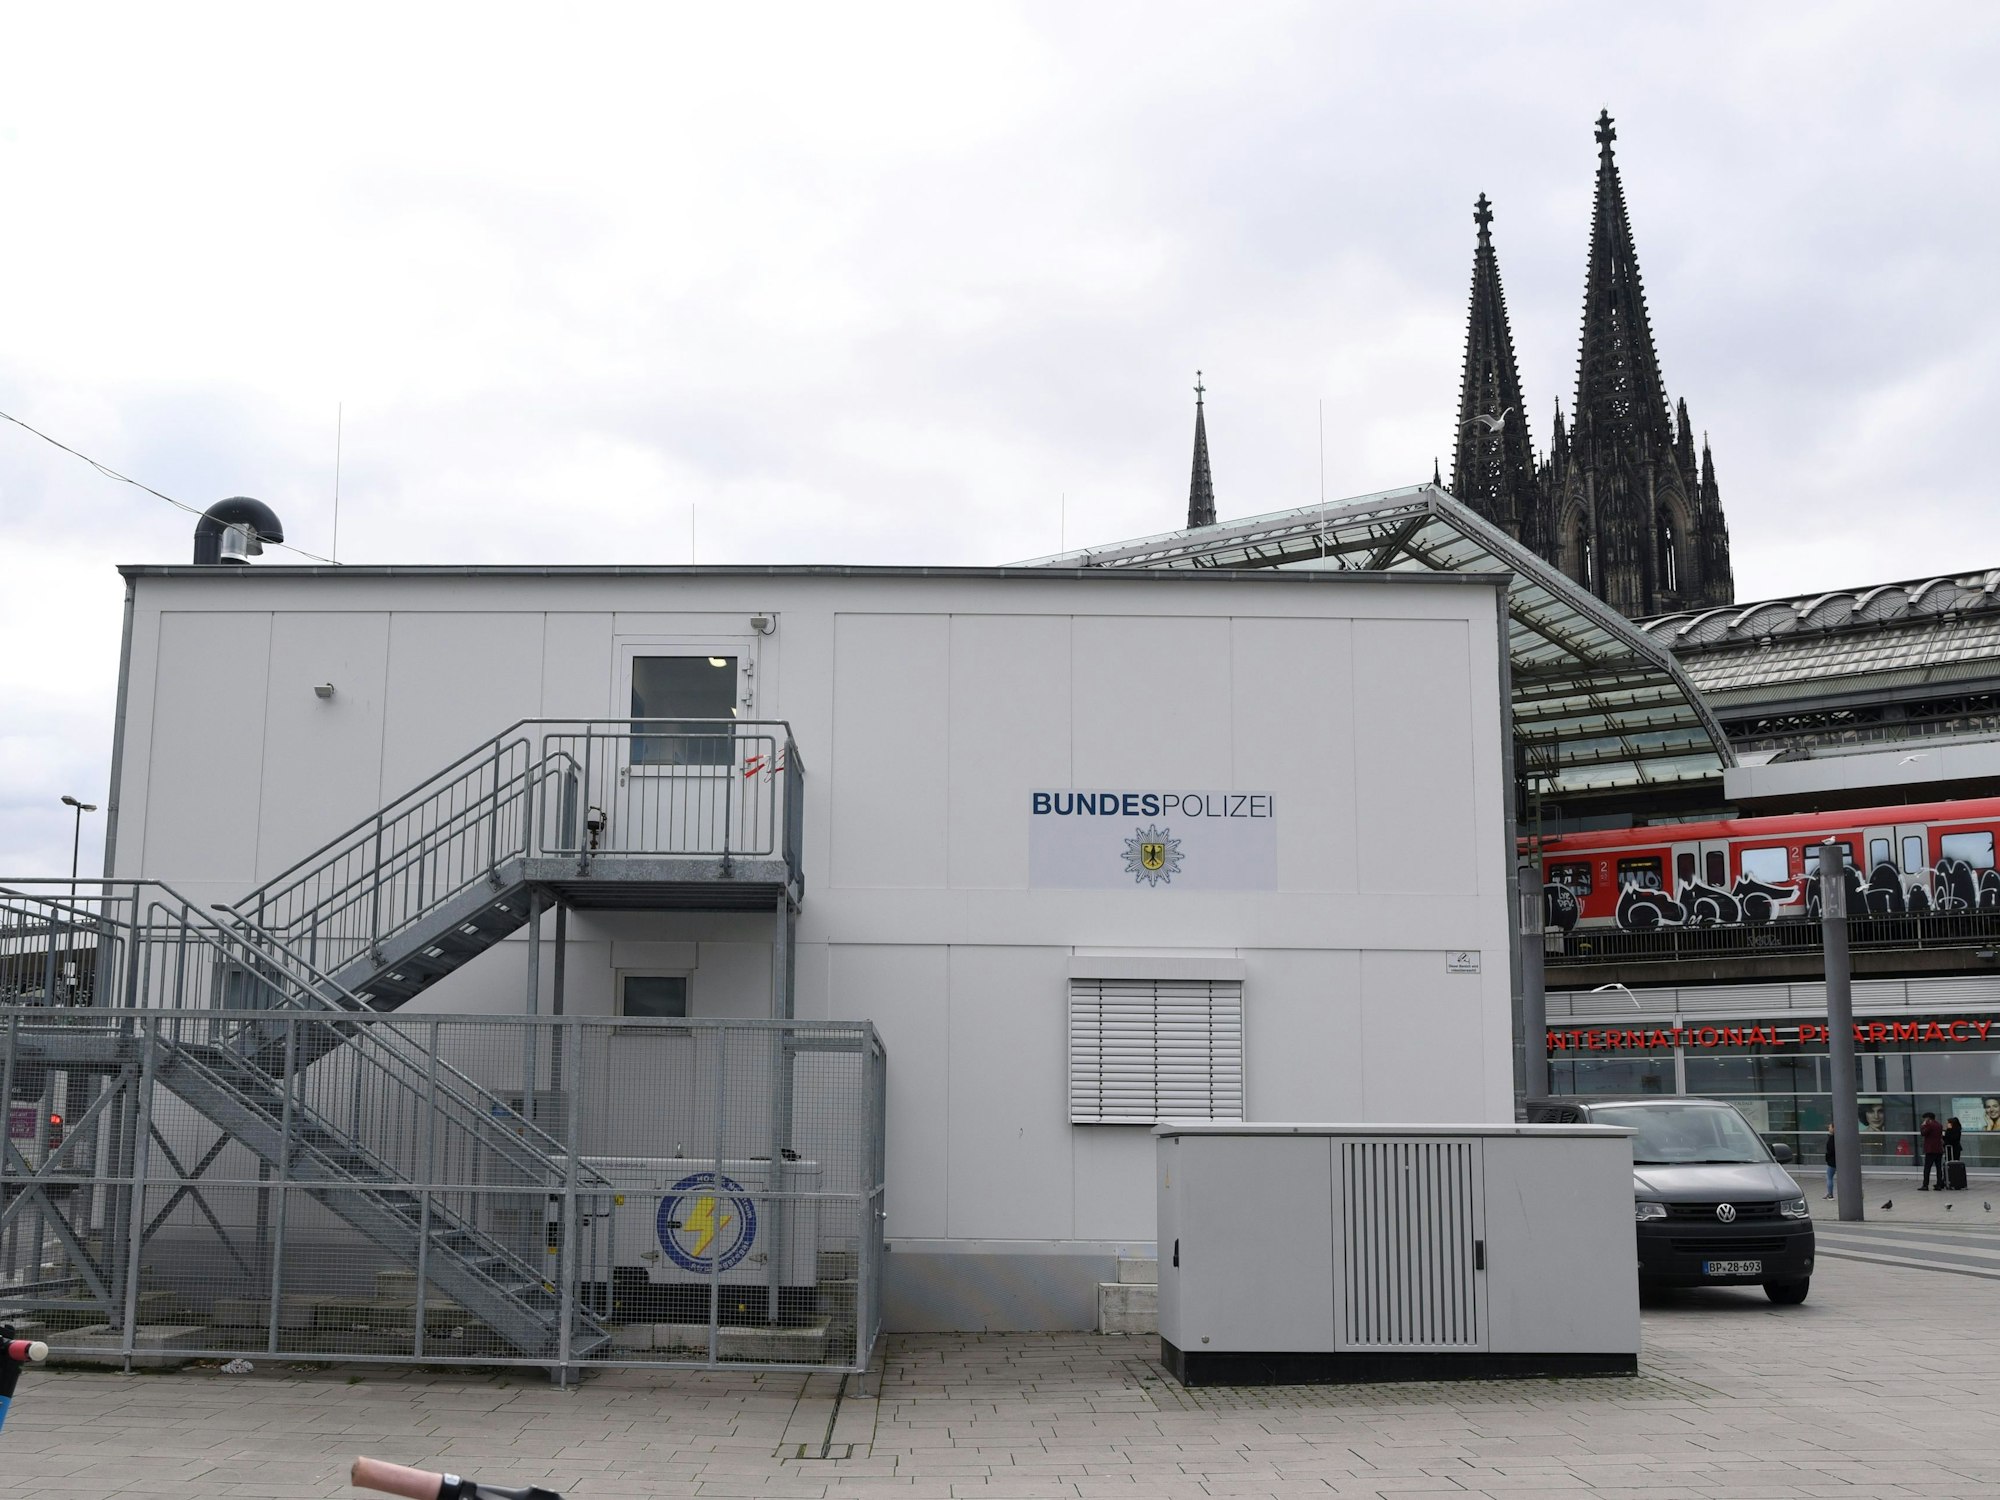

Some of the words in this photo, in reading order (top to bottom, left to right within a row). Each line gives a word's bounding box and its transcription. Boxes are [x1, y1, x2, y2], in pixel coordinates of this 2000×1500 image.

[1032, 792, 1273, 818] BUNDESPOLIZEI
[1791, 847, 1799, 858] 2
[1600, 861, 1608, 872] 2
[1547, 1025, 1785, 1050] NTERNATIONAL
